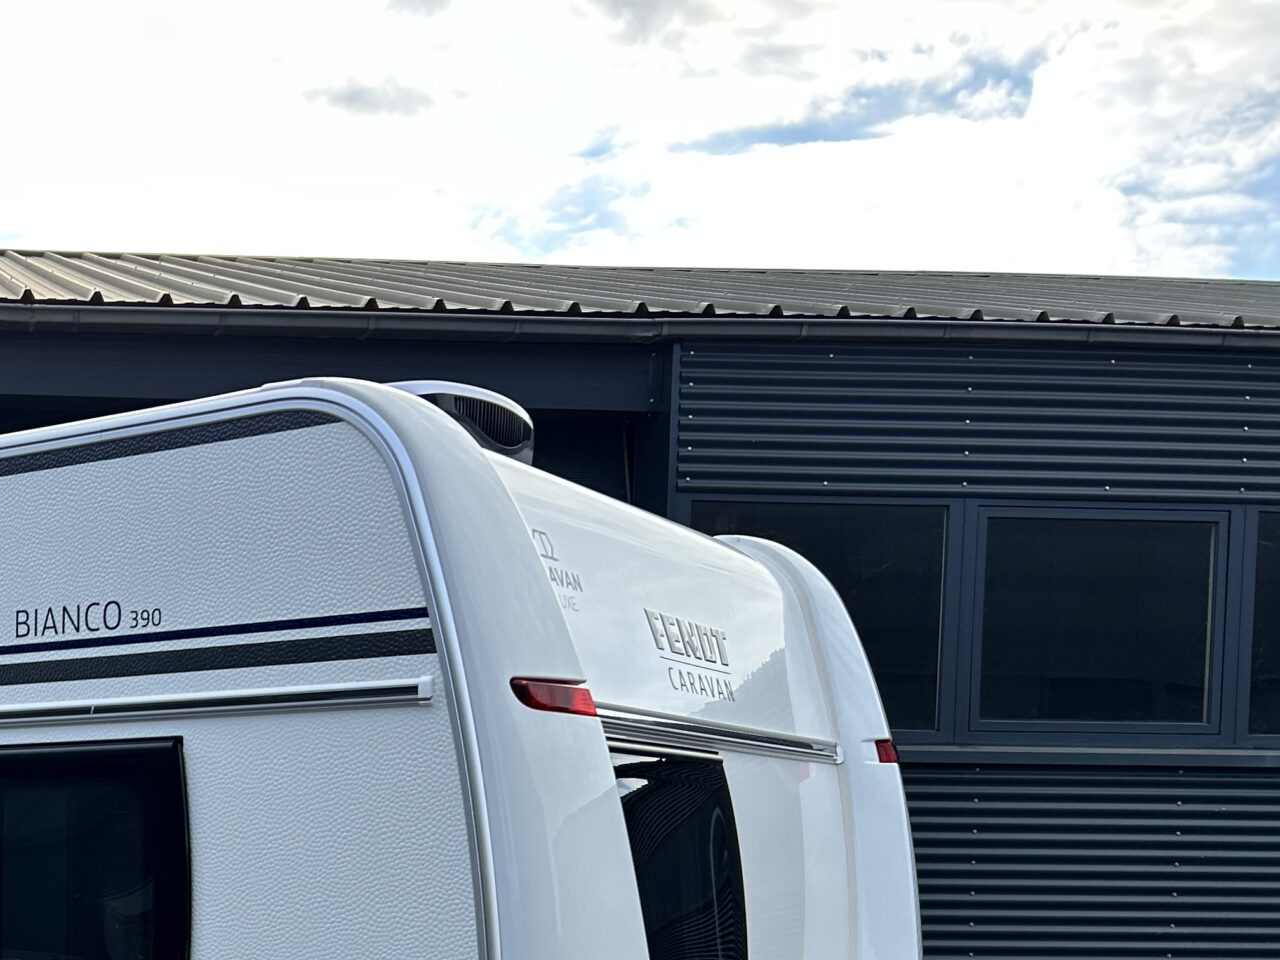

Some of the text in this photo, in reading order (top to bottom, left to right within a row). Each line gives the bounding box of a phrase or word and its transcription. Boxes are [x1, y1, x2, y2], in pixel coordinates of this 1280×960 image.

[548, 566, 583, 592] AVAN
[15, 600, 162, 638] BIANCO 390
[643, 607, 728, 666] FENDT
[668, 667, 736, 702] CARAVAN
